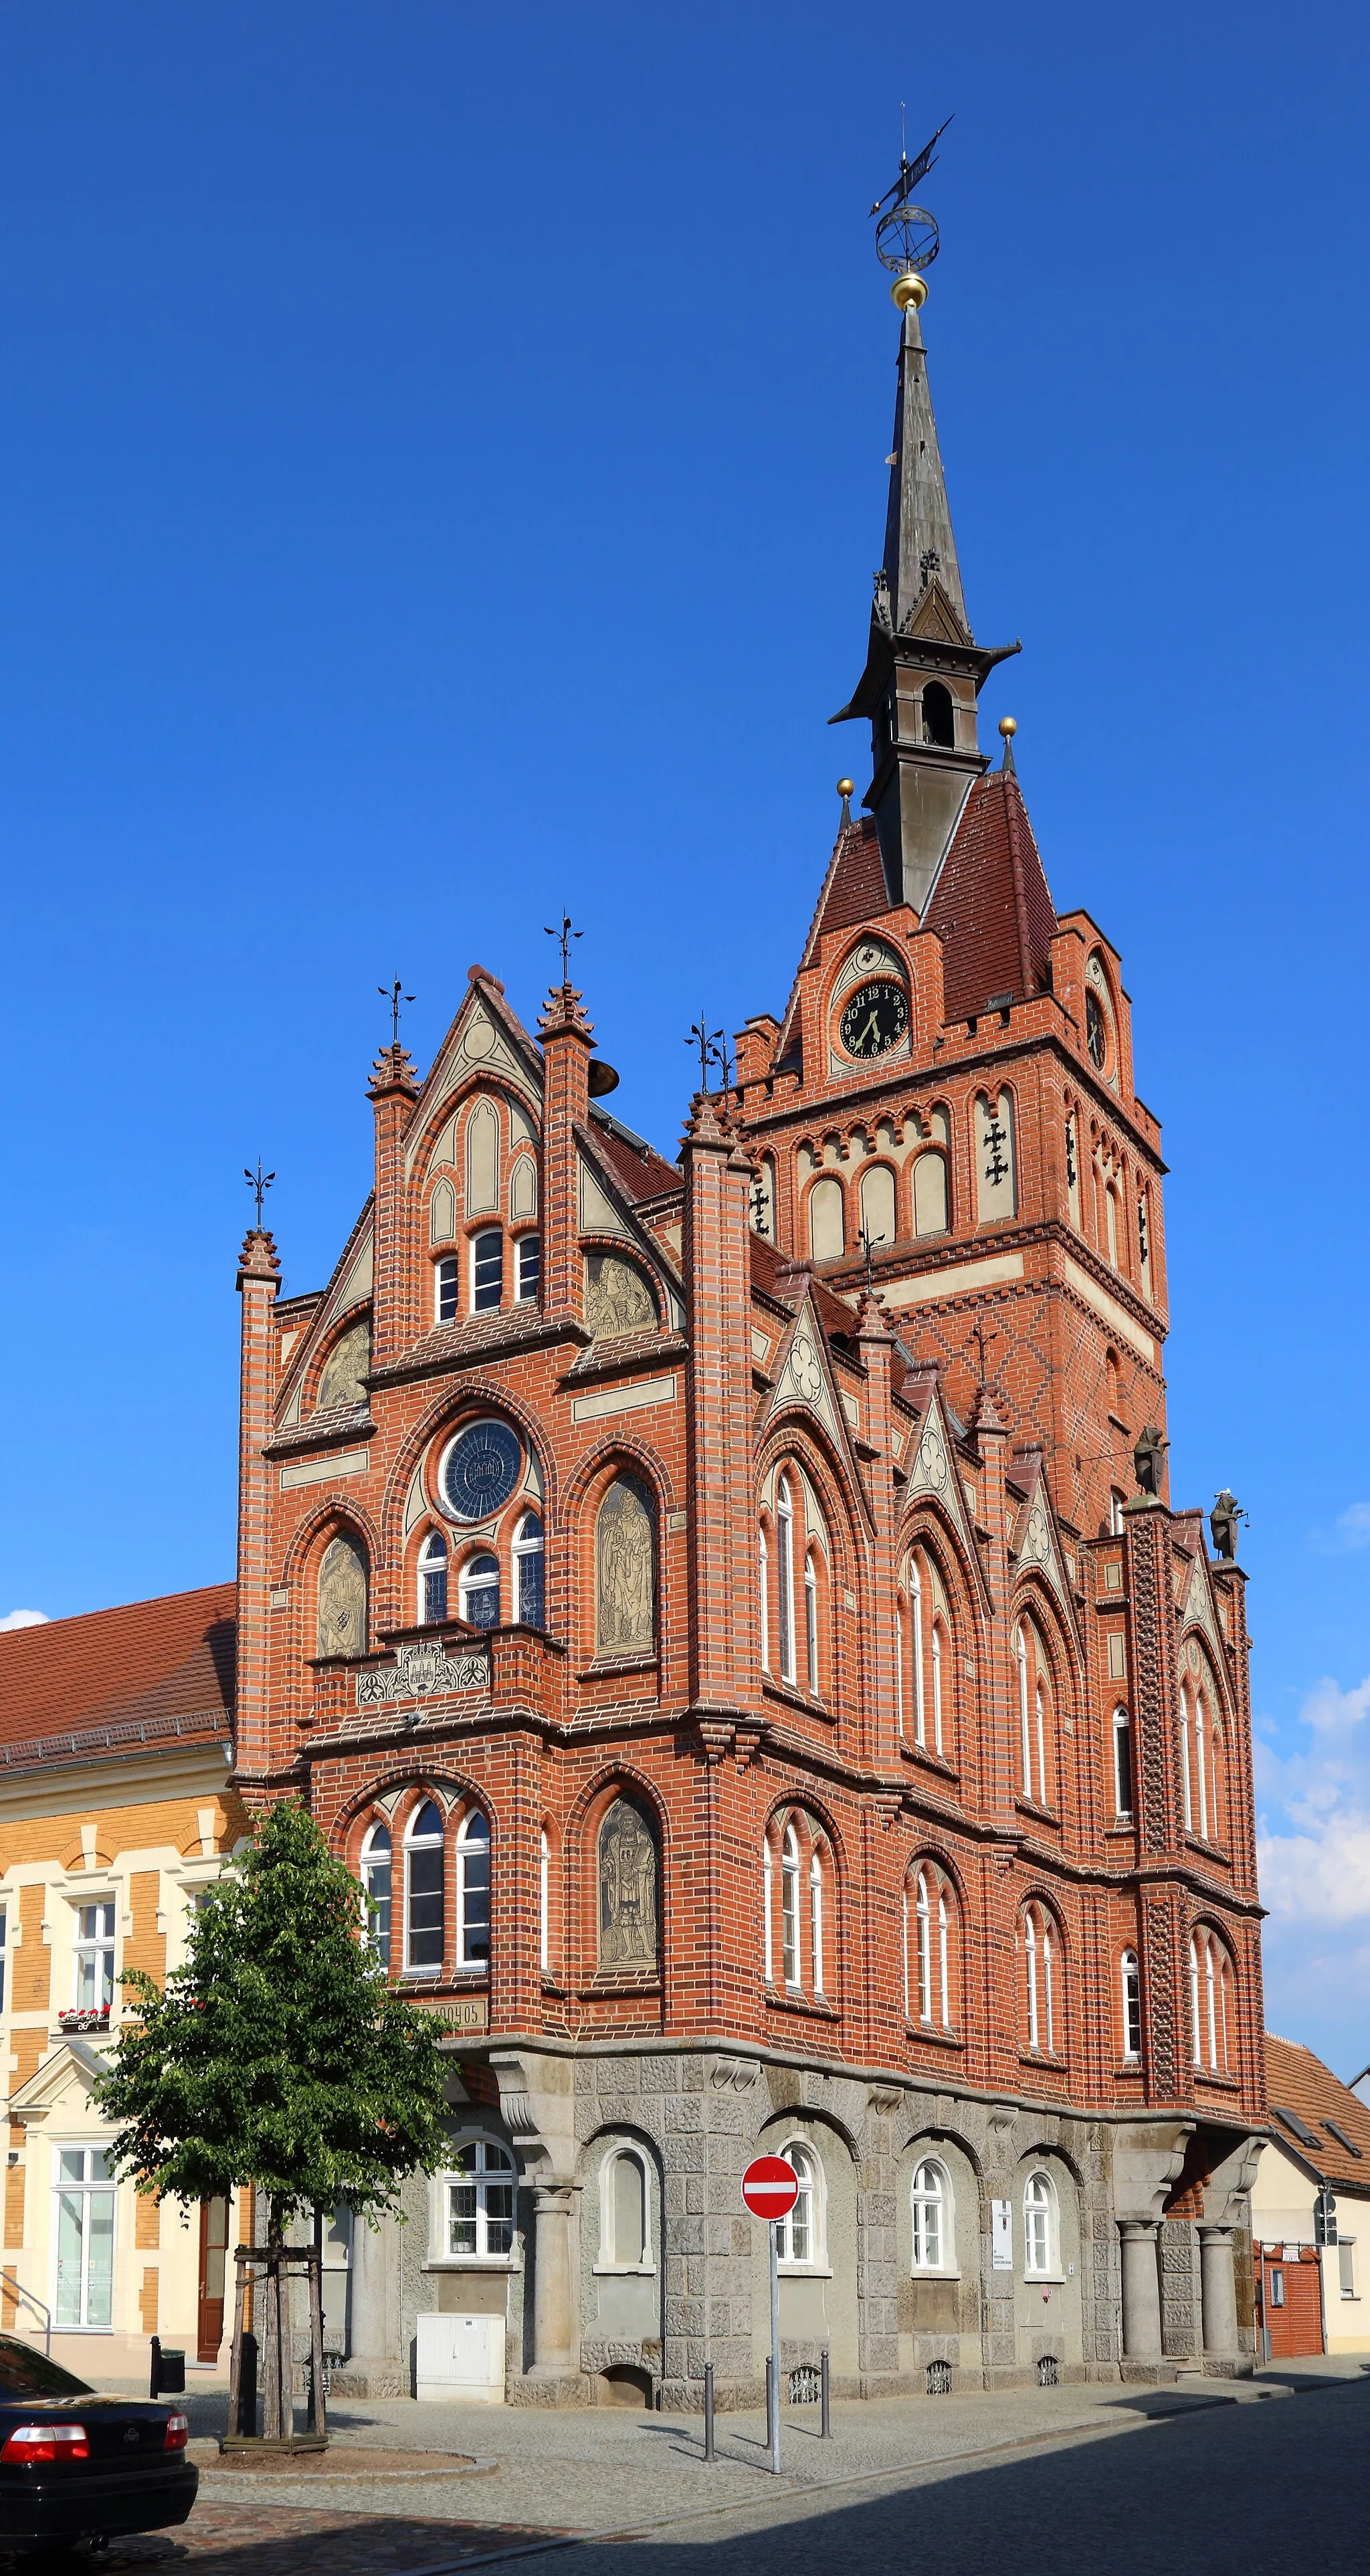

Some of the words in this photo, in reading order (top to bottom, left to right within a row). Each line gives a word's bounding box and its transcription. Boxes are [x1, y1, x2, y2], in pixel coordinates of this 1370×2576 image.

[868, 988, 880, 1001] 12
[884, 989, 889, 999] 1
[856, 995, 866, 1008] 11
[893, 995, 900, 1006] 2
[847, 1008, 858, 1021] 10
[897, 1007, 904, 1018] 3
[844, 1023, 852, 1035] 9
[894, 1022, 901, 1033] 4
[849, 1035, 856, 1047] 8
[884, 1035, 891, 1046] 5
[871, 1042, 878, 1054] 6
